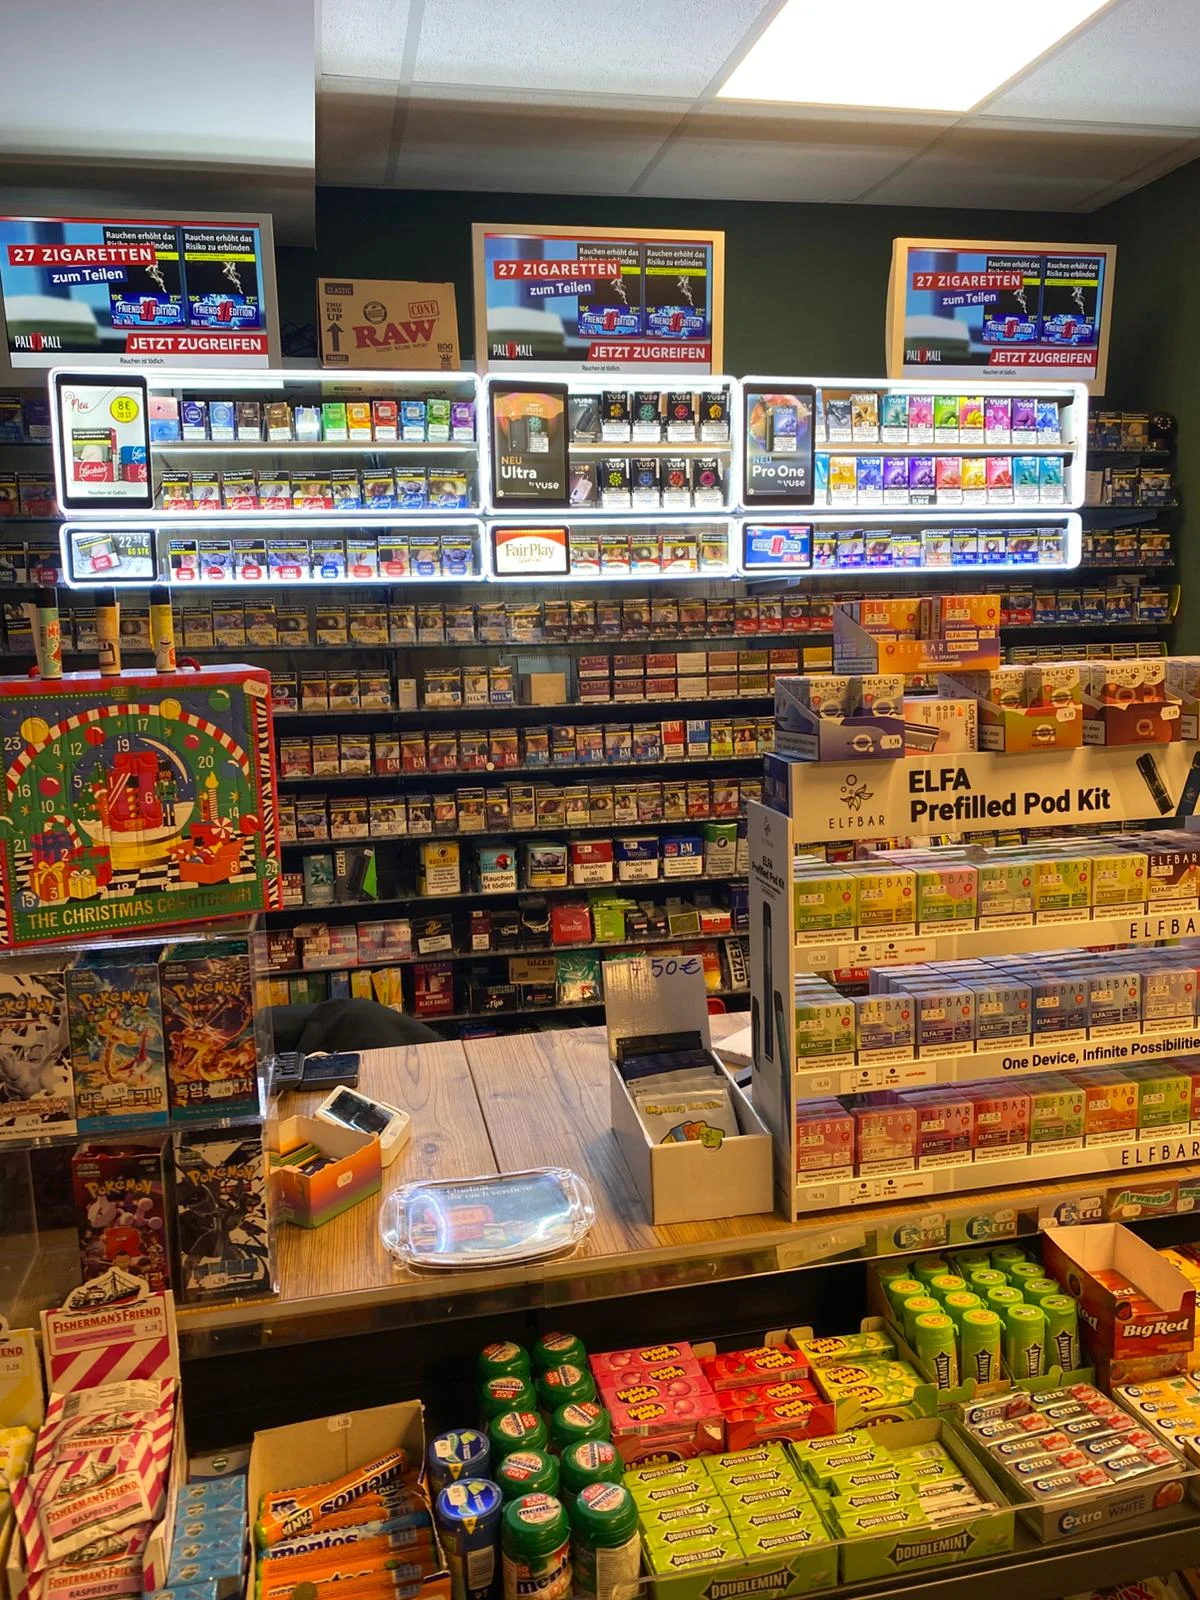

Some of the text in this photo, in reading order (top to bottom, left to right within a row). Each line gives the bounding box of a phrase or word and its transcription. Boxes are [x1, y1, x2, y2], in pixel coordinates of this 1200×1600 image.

[106, 231, 176, 242] Rauchen erhöht das
[184, 233, 252, 244] Rauchen erhöht das
[186, 242, 206, 250] Risiko
[217, 242, 250, 252] erblinden
[579, 247, 606, 256] Rauchen
[606, 248, 625, 256] erhöht
[646, 249, 672, 258] Rauchen
[673, 250, 692, 258] erhöht
[14, 248, 152, 262] 27 ZIGARETTEN
[646, 258, 663, 266] Risiko
[674, 258, 703, 267] erblinden
[52, 268, 124, 284] zum Teilen
[498, 263, 618, 276] 27 ZIGARETTEN
[1046, 270, 1062, 278] Risiko
[1070, 270, 1096, 278] erblinden
[916, 275, 1020, 287] 27 ZIGARETTEN
[326, 286, 352, 294] CLASSIC
[530, 281, 592, 296] zum Teilen
[942, 292, 996, 306] zum Teilen
[117, 304, 178, 317] FRIENDS EDITION
[194, 305, 254, 318] FRIENDS EDITION
[411, 302, 437, 316] CONE
[327, 314, 342, 322] UP
[584, 314, 636, 327] FRIENDS EDITION
[651, 316, 701, 328] FRIENDS EDITION
[352, 319, 436, 349] RAW
[14, 336, 62, 348] PALL MALL
[130, 338, 262, 350] JETZT ZUGREIFEN
[493, 344, 533, 357] PALL MALL
[592, 346, 706, 359] JETZT ZUGREIFEN
[906, 350, 942, 362] PALL MALL
[992, 352, 1092, 364] JETZT ZUGREIFEN
[72, 398, 88, 411] Neu
[502, 456, 522, 464] NEU
[752, 456, 772, 464] NEU
[501, 466, 537, 479] Ultra
[752, 465, 805, 477] Pro One
[1045, 670, 1075, 678] ELFLIQ
[1110, 668, 1140, 676] ELFLIQ
[814, 680, 846, 689] ELFLIQ
[866, 678, 900, 686] ELFLIQ
[138, 718, 149, 731] 17
[4, 738, 21, 751] 23
[52, 744, 60, 756] 4
[70, 742, 82, 756] 12
[116, 739, 130, 752] 19
[198, 755, 214, 768] 20
[74, 776, 82, 788] 5
[908, 768, 972, 793] ELFA
[18, 784, 30, 797] 16
[144, 792, 153, 804] 6
[41, 800, 54, 813] 10
[911, 788, 1111, 823] Prefilled Pod Kit
[229, 806, 240, 819] 14
[828, 814, 886, 830] ELFBAR
[14, 840, 27, 852] 21
[62, 848, 68, 861] 2
[1150, 854, 1198, 866] ELFBAR
[230, 860, 238, 873] 8
[264, 861, 279, 877] 24
[482, 874, 514, 883] Rauchen
[860, 877, 912, 890] ELFBAR
[50, 888, 58, 900] 3
[22, 894, 35, 908] 15
[27, 887, 252, 930] THE CHRISTMAS COUNTDOWN
[729, 941, 746, 982] GIZEH
[921, 996, 971, 1009] ELFBAR
[1002, 1057, 1028, 1070] One
[1032, 1051, 1080, 1066] Device,
[1083, 1044, 1128, 1061] Infinite
[800, 1123, 850, 1137] ELFBAR
[1122, 1142, 1200, 1166] ELFBAR
[1116, 1190, 1172, 1204] Airwaves
[1060, 1208, 1102, 1222] Extra
[972, 1219, 1016, 1236] Extra
[900, 1228, 947, 1246] Extra
[53, 1306, 162, 1334] FISHERMAN'S FRIEND
[569, 1404, 592, 1424] mentos
[971, 1406, 1001, 1422] extra
[982, 1421, 1015, 1436] extra
[58, 1437, 114, 1451] FISHERMAN'S
[1000, 1440, 1035, 1454] extra
[642, 1464, 686, 1481] DOUBLEMINT
[320, 1462, 402, 1514] mentos
[652, 1484, 698, 1500] DOUBLEMINT
[46, 1481, 140, 1524] FISHERMAN'S FRIEND
[590, 1487, 620, 1509] mentos
[72, 1502, 119, 1526] RASPBERRY
[662, 1504, 708, 1521] DOUBLEMINT
[1062, 1510, 1102, 1531] extra
[1108, 1500, 1145, 1518] WHITE
[282, 1511, 314, 1536] FANTA
[270, 1534, 358, 1558] mentos
[896, 1534, 968, 1562] DOUBLEMINT
[711, 1570, 790, 1599] DOUBLEMINT
[69, 1584, 119, 1599] RASPBERRY
